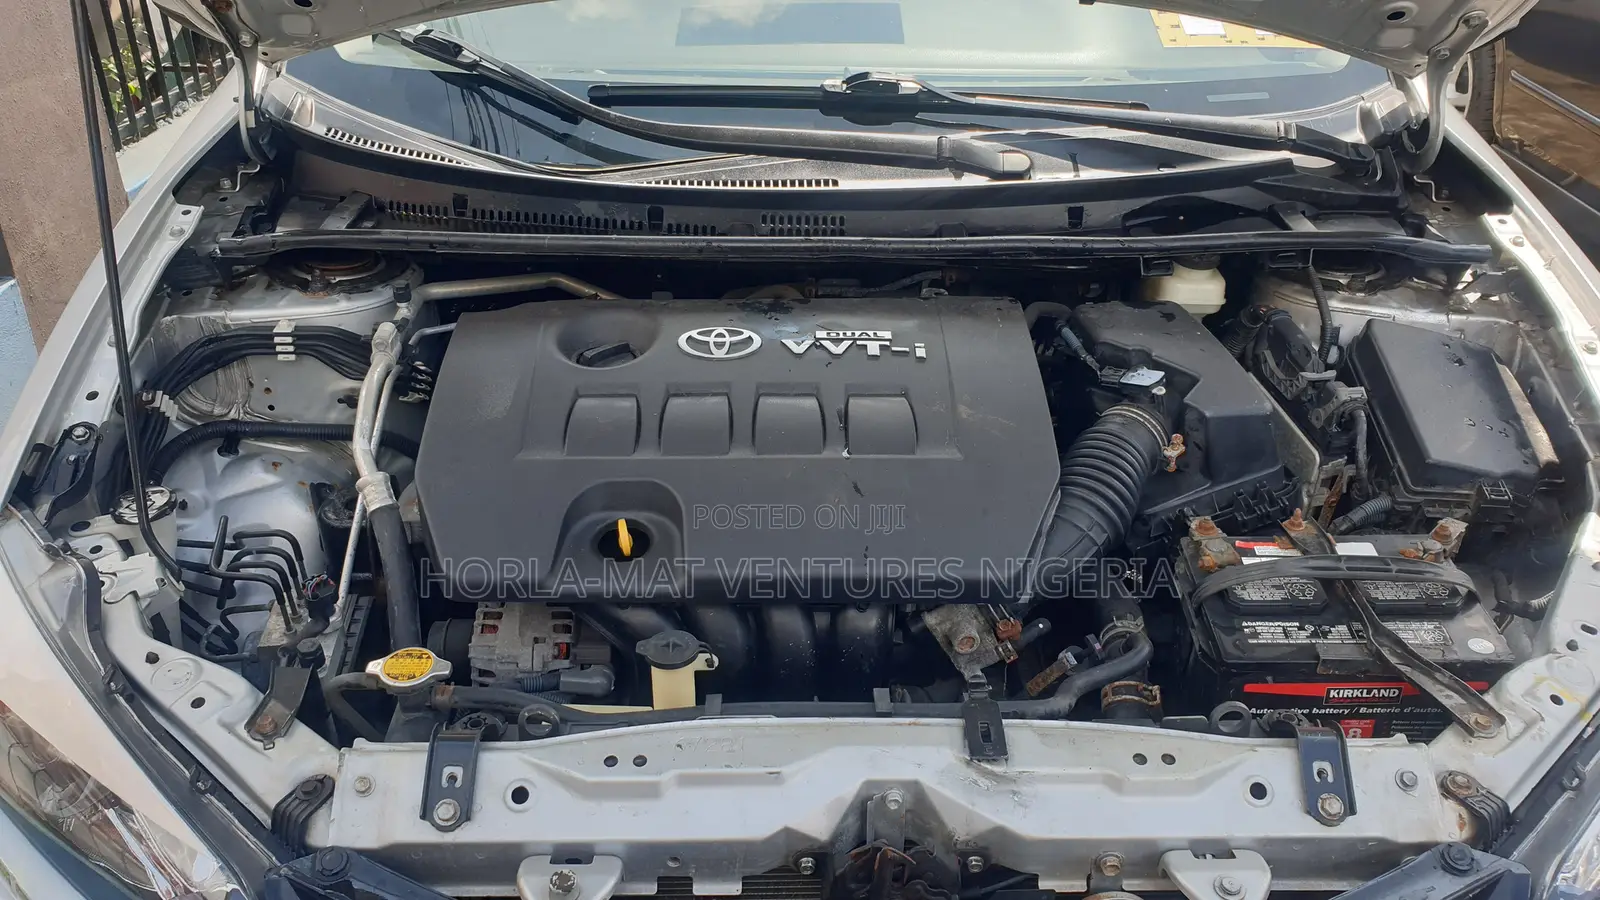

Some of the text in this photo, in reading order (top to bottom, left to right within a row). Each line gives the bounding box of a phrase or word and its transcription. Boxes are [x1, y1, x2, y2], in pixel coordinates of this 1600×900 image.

[823, 330, 888, 338] DUAL
[780, 338, 927, 360] VVT-i
[1328, 688, 1400, 698] KIRKLAND
[1311, 706, 1351, 715] battery
[1358, 706, 1400, 714] Batterie
